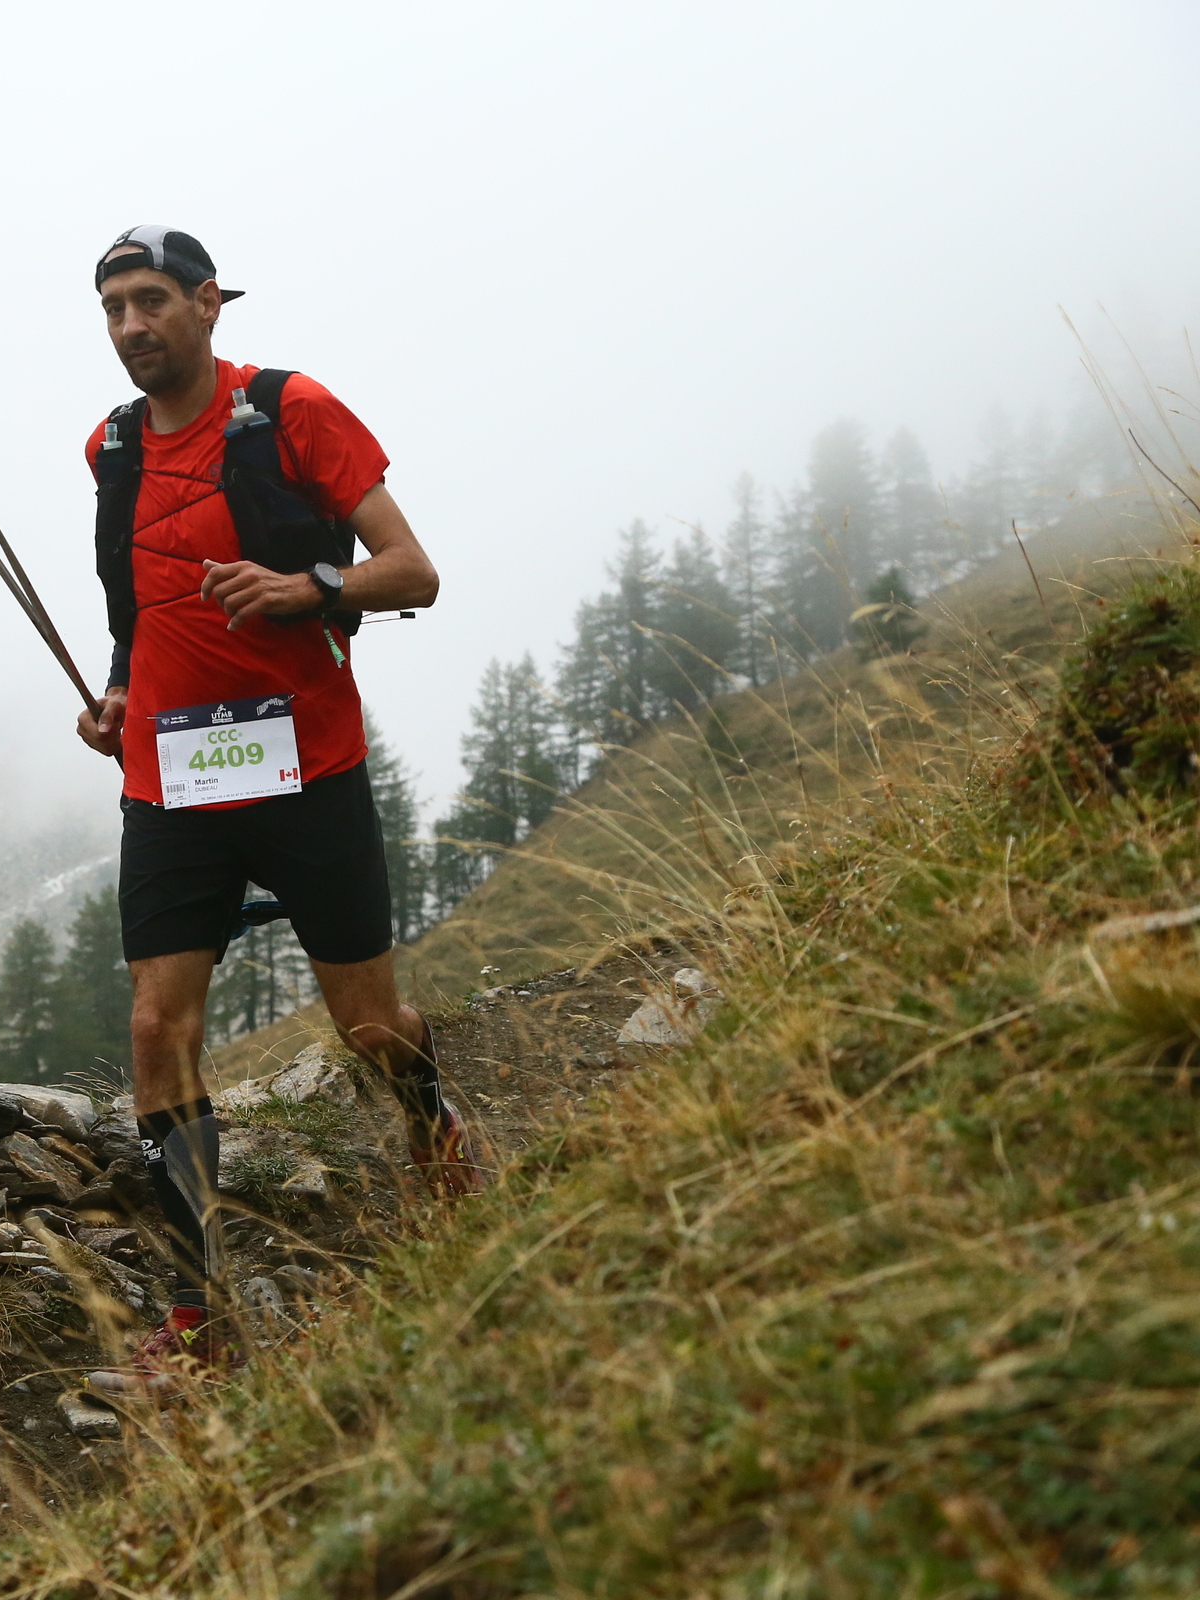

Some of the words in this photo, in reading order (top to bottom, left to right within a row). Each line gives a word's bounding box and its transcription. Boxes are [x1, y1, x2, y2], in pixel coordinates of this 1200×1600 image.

[211, 711, 233, 719] UTMB
[188, 742, 265, 772] 4409
[194, 777, 219, 786] Martin
[194, 785, 218, 793] DUBEAU
